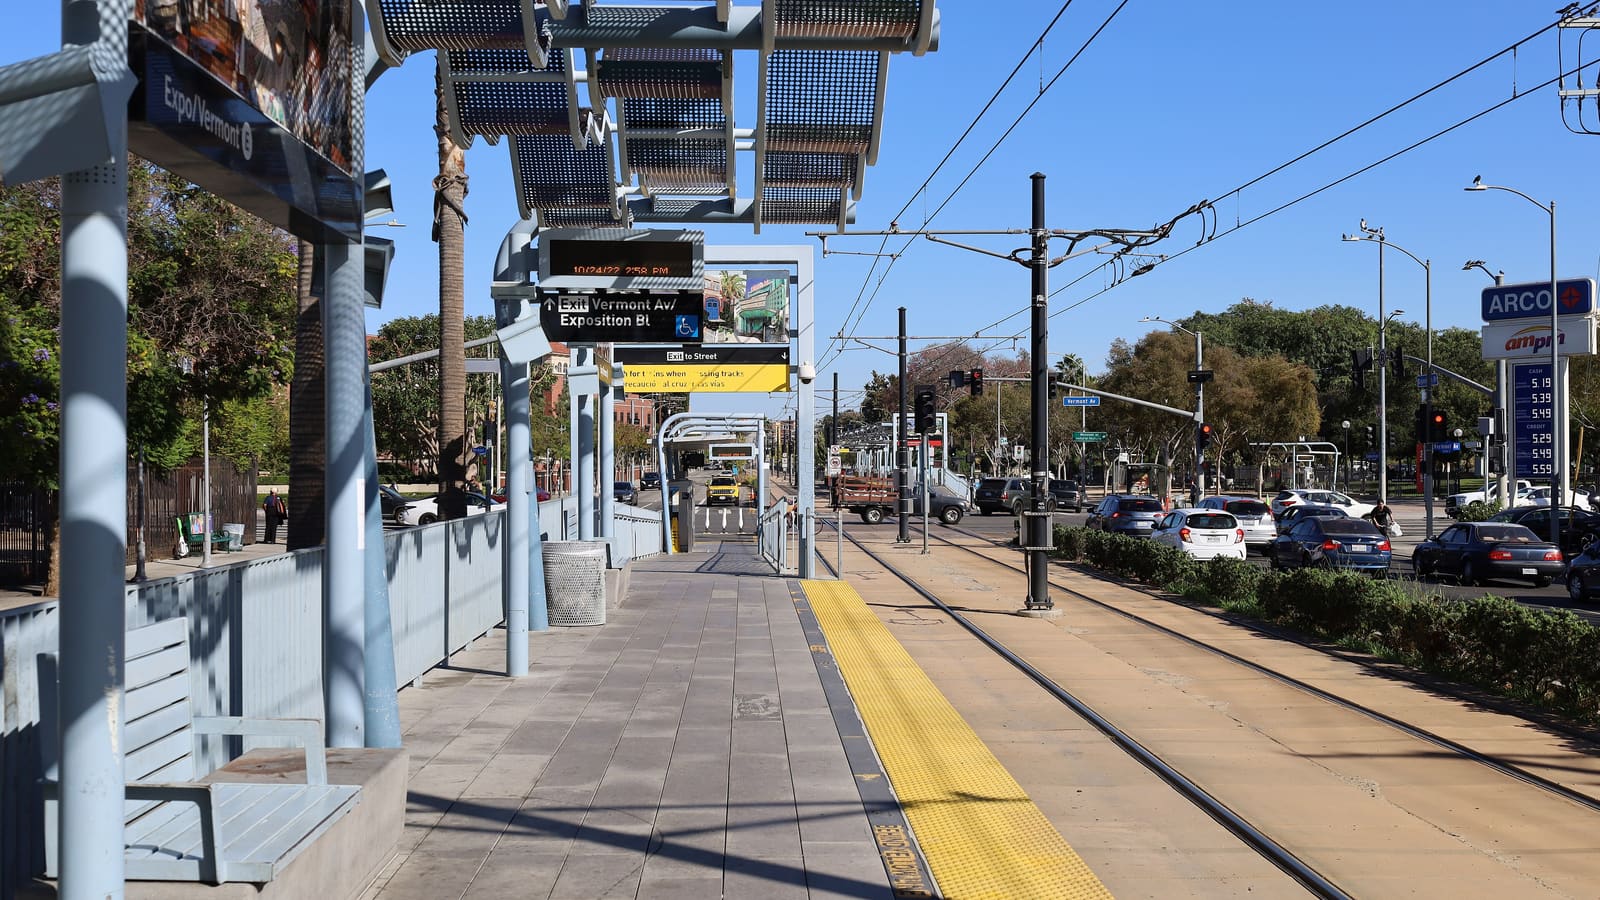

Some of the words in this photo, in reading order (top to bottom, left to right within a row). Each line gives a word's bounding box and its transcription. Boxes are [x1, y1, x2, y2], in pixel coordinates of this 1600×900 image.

[164, 74, 240, 150] Expo/Vermont
[573, 265, 620, 274] 10/24/22
[625, 265, 648, 274] 2:58
[652, 266, 670, 275] PM
[560, 297, 588, 311] Exit
[592, 298, 651, 311] Vermont
[653, 298, 677, 312] Av/
[1489, 289, 1552, 314] ARCO
[560, 313, 632, 329] Exposition
[635, 314, 651, 327] Bl
[1505, 333, 1565, 354] ampm
[668, 352, 683, 360] Exit
[693, 352, 718, 360] Street
[1531, 377, 1551, 388] 5.19
[1531, 393, 1551, 404] 5.39
[1532, 408, 1551, 419] 5.49
[1532, 433, 1552, 444] 5.29
[1532, 448, 1552, 459] 5.49
[1532, 464, 1552, 474] 5.59
